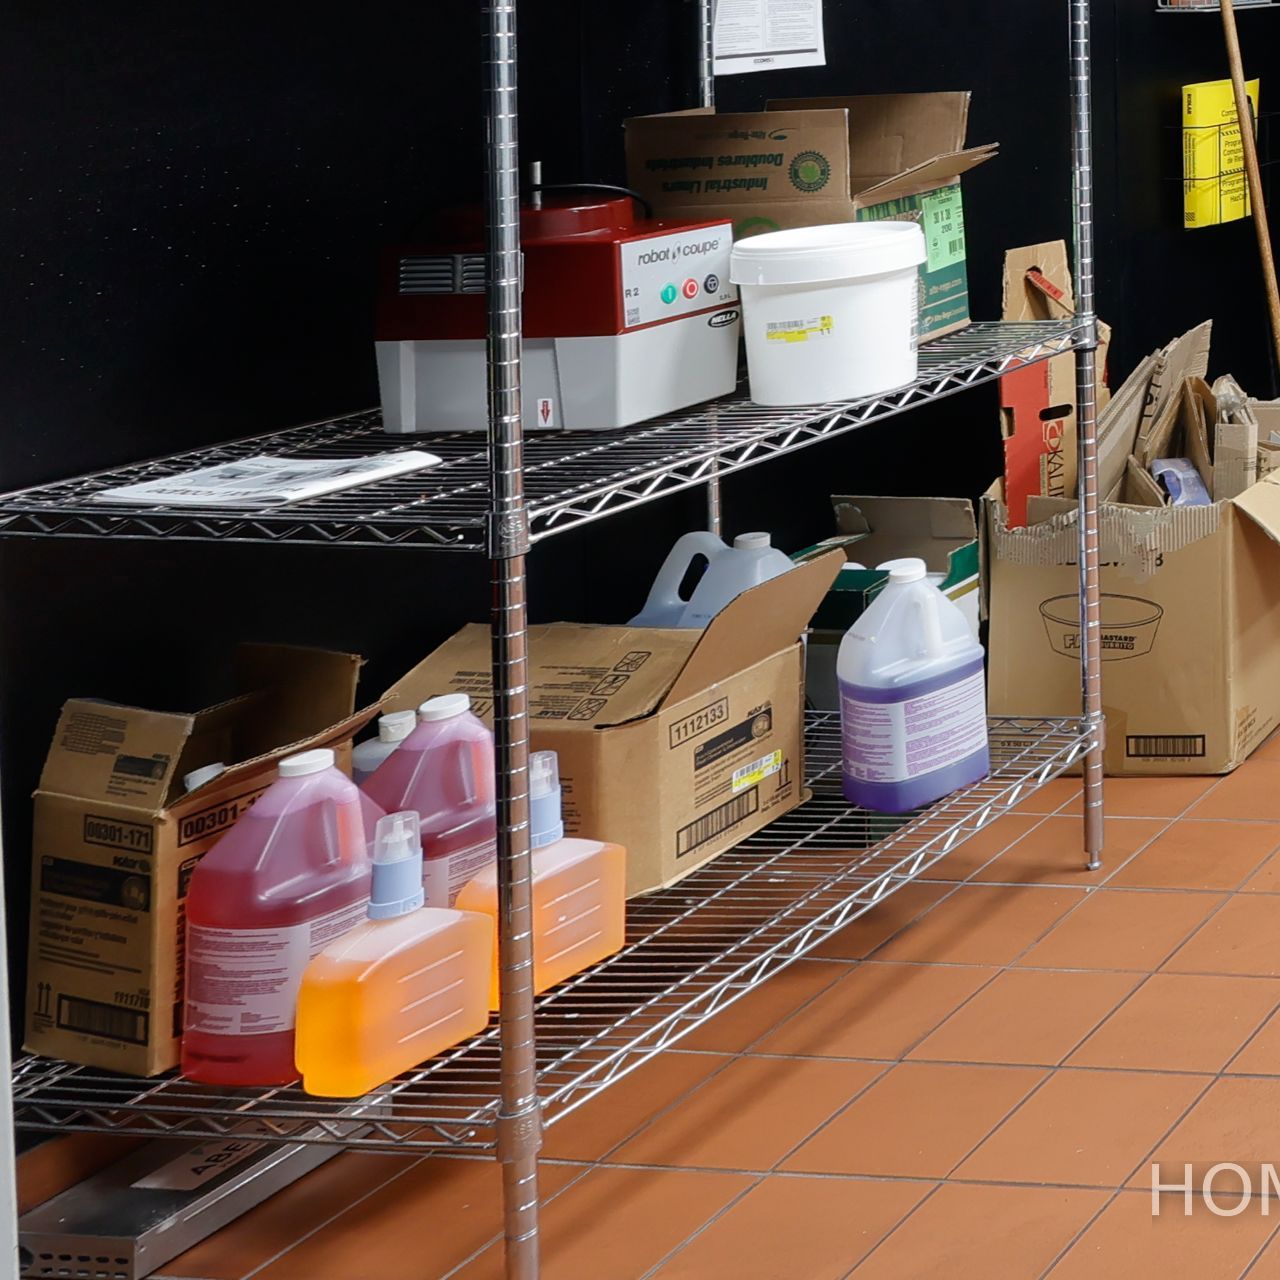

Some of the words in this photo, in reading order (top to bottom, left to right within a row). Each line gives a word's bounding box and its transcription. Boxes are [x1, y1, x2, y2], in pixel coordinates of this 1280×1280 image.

[704, 177, 768, 193] Industrial
[638, 247, 670, 266] robot
[682, 239, 719, 256] coupe
[625, 289, 632, 298] R
[633, 287, 640, 297] 2
[711, 311, 737, 323] NELLA
[1100, 634, 1134, 642] ASTARD
[1100, 641, 1135, 650] URRITO
[674, 705, 724, 741] 1112133
[183, 793, 264, 838] 00301-1
[87, 821, 150, 848] 00301-171
